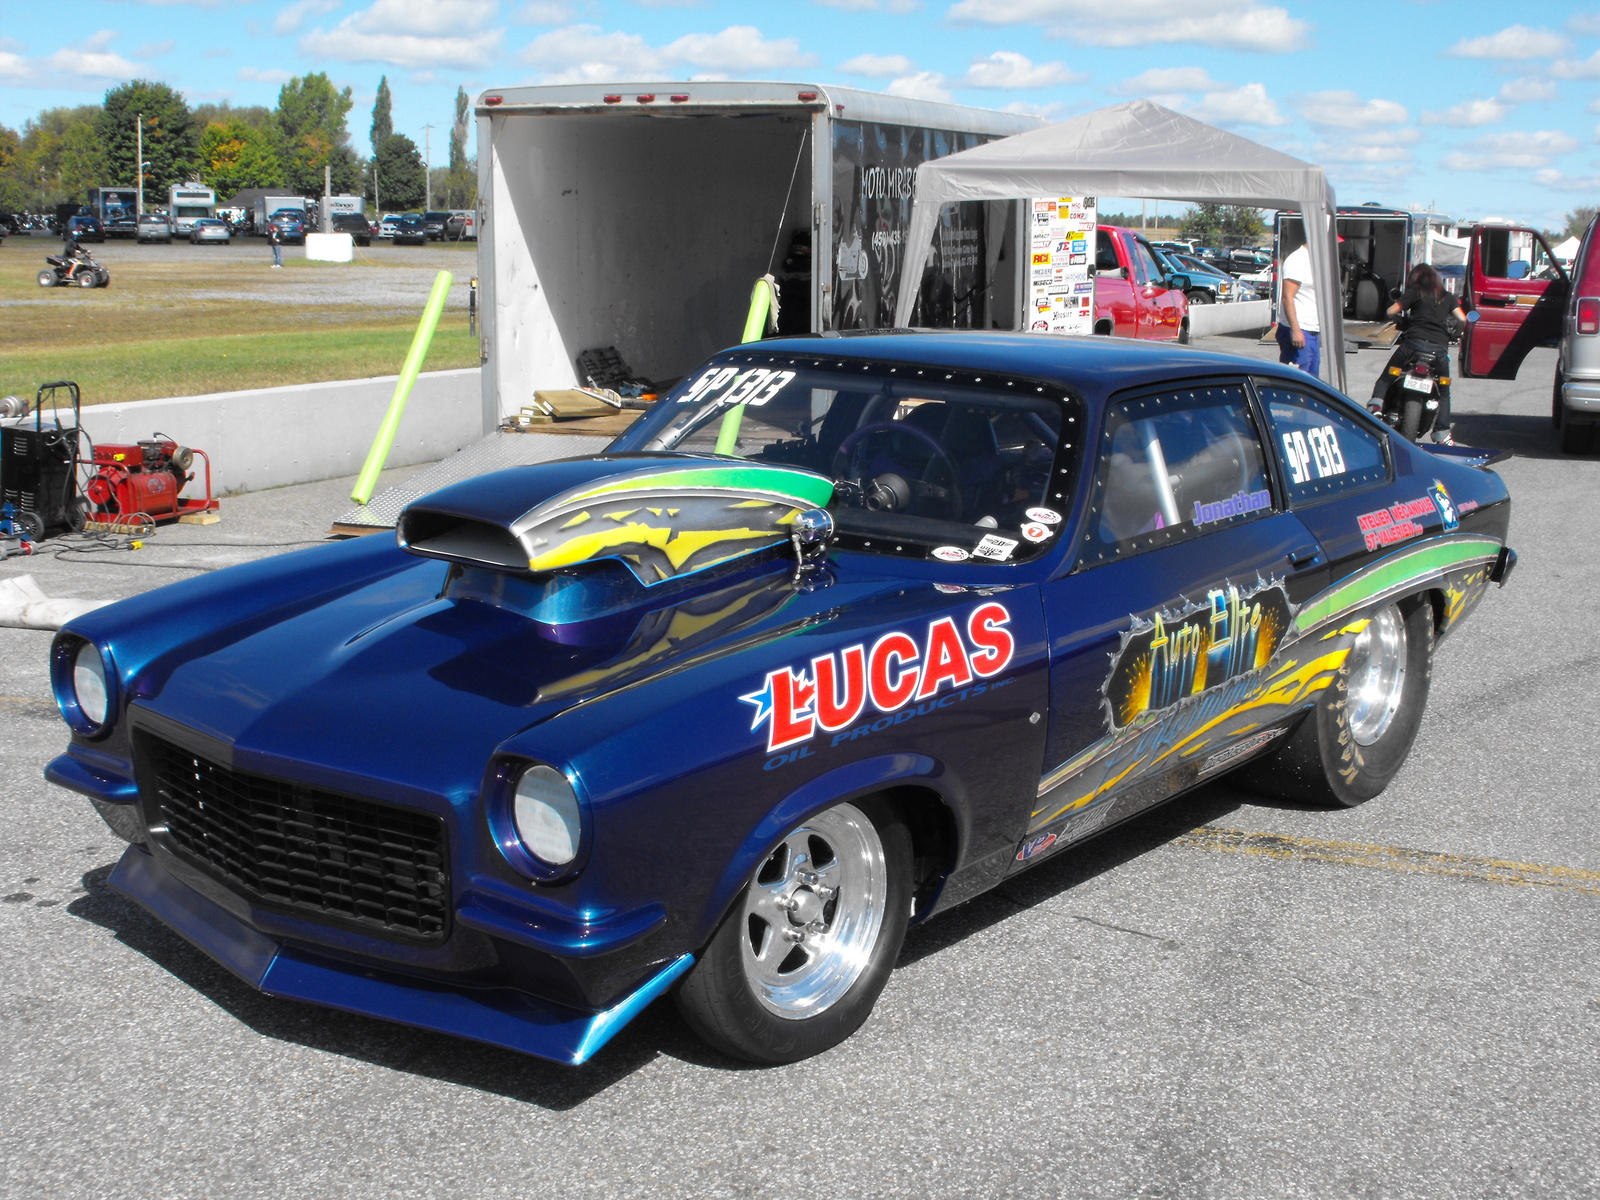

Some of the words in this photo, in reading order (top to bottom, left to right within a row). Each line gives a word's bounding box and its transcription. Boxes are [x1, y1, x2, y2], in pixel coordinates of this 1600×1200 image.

[861, 167, 886, 199] MOTO
[677, 367, 740, 403] SP
[717, 368, 797, 406] 1313
[1282, 430, 1311, 484] SP
[1307, 425, 1346, 478] 1313
[1192, 489, 1272, 526] Jonathan
[1357, 509, 1395, 534] ATELIER
[1388, 496, 1437, 523] MÉCANIQUE
[1150, 612, 1200, 673] Auto
[766, 602, 1015, 752] LUCAS
[763, 745, 817, 772] OIL
[830, 681, 988, 748] PRODUCTS
[990, 676, 1018, 691] INC.
